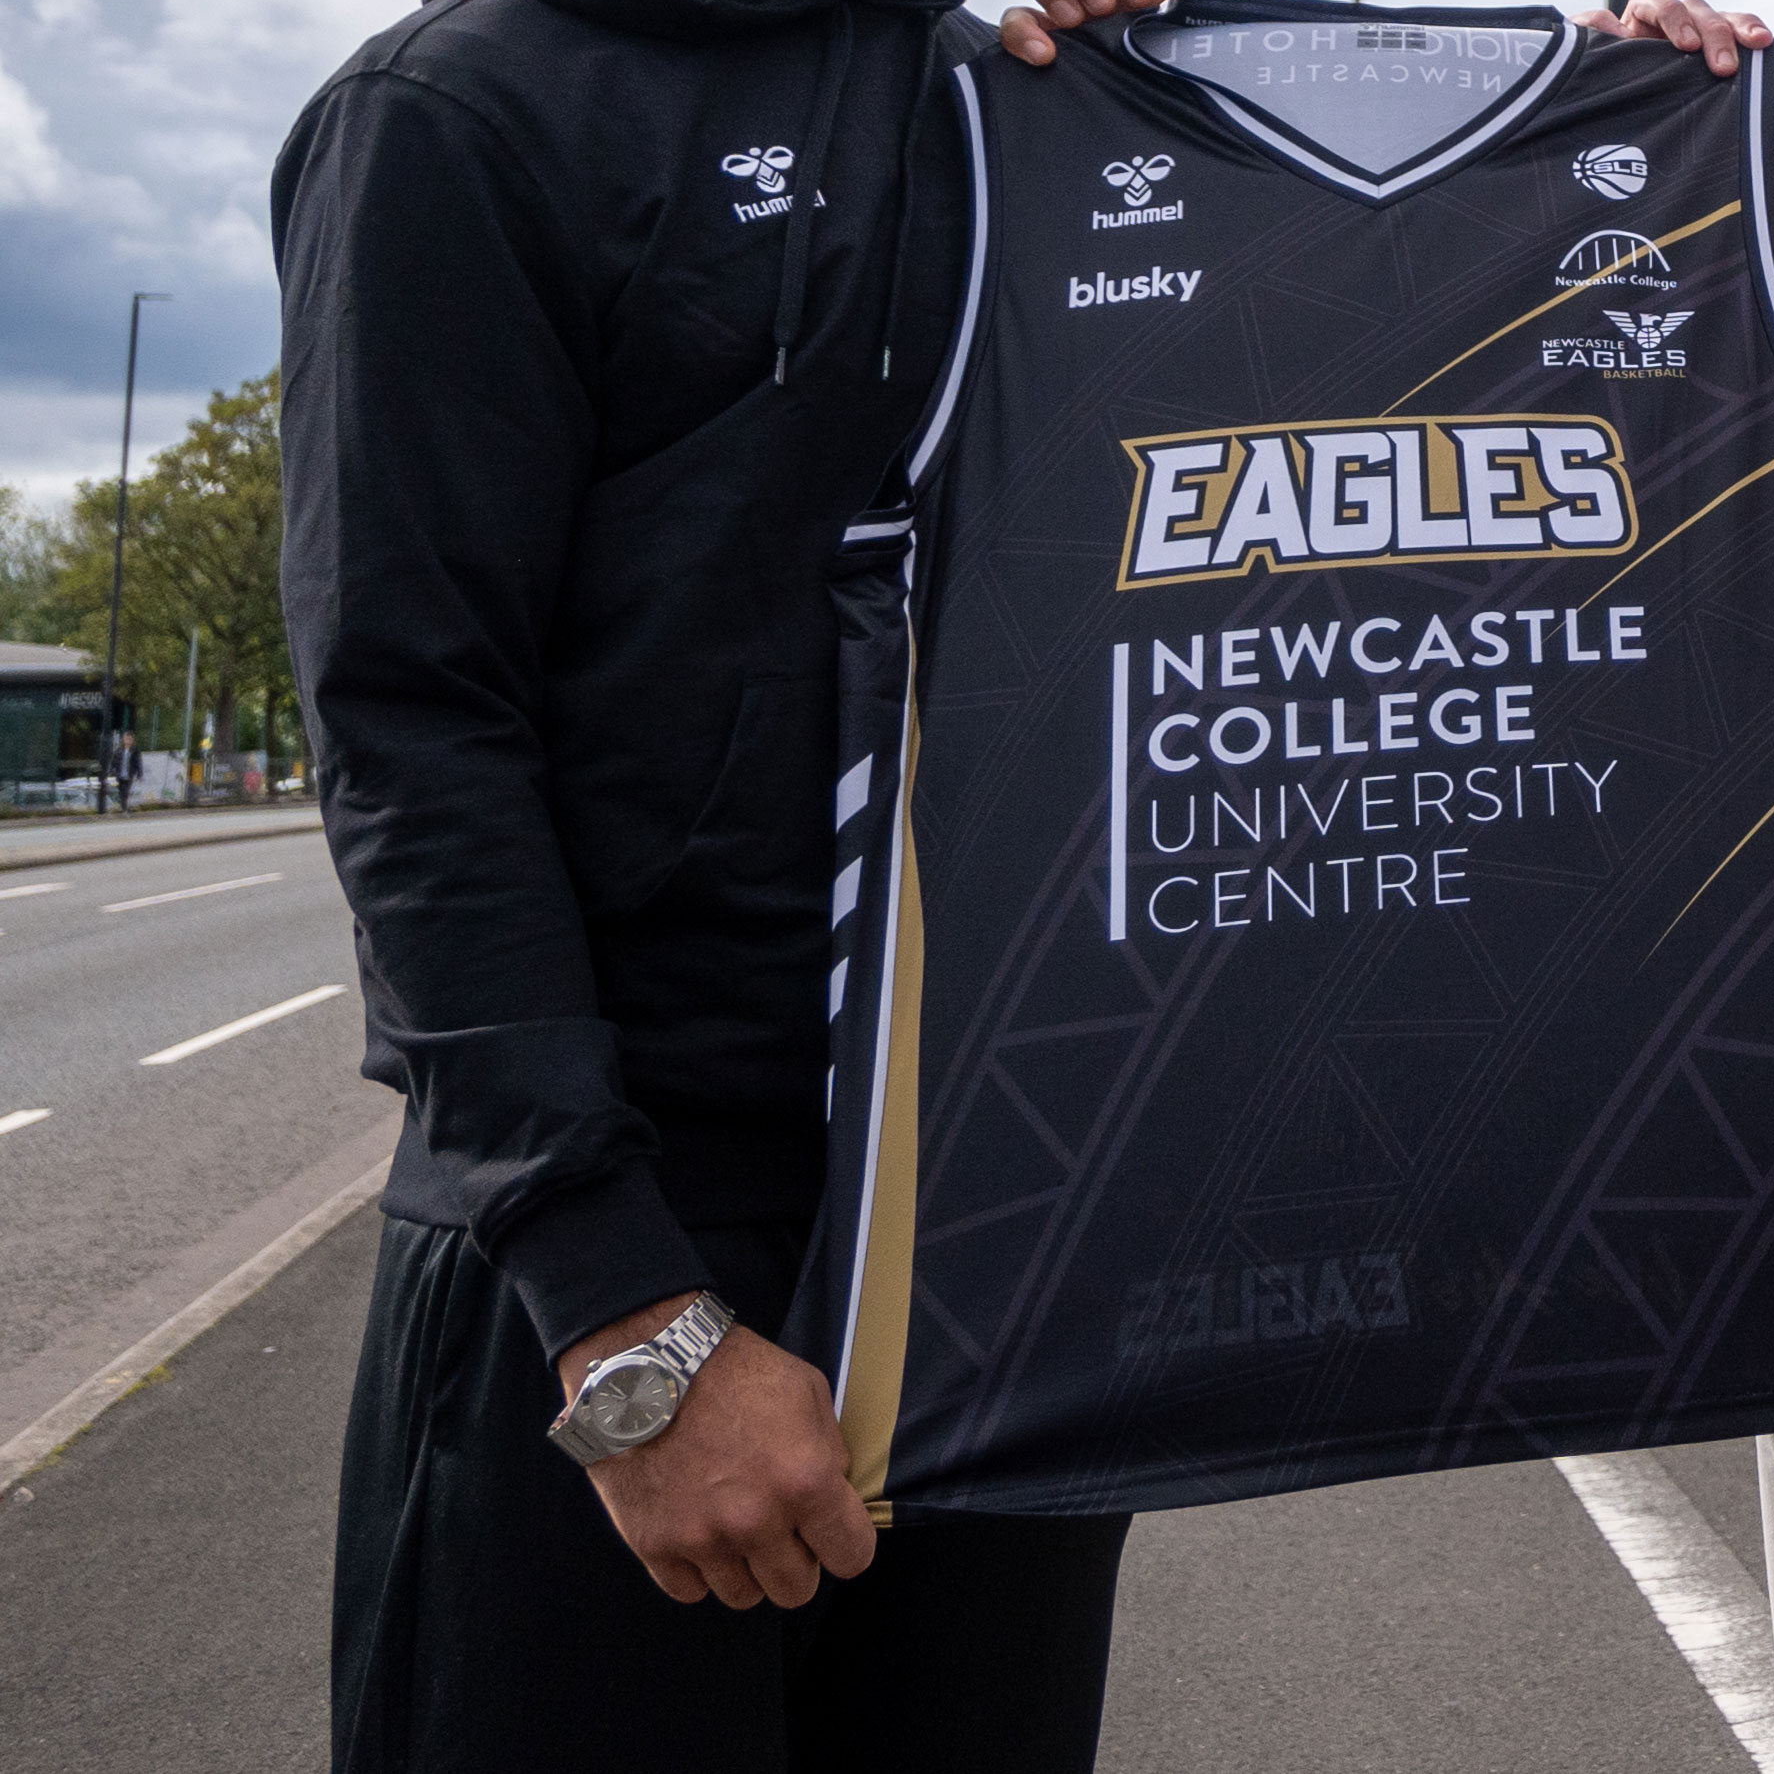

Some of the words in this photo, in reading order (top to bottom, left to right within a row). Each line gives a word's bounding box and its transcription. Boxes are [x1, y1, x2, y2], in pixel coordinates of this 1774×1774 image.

[1592, 160, 1649, 176] SLB
[733, 188, 827, 224] huml
[1092, 199, 1184, 231] hummel
[1068, 265, 1203, 310] blusky
[1554, 273, 1627, 289] Newcastle
[1629, 274, 1678, 291] College
[1541, 337, 1626, 351] NEWCASTLE
[1541, 348, 1687, 369] EAGLES
[1602, 368, 1687, 380] BASKETBALL
[1130, 424, 1630, 578] EAGLES
[1152, 606, 1648, 696] NEWCASTLE
[1148, 685, 1536, 773] COLLEGE
[1150, 759, 1618, 855] UNIVERSITY
[1147, 847, 1472, 935] CENTRE
